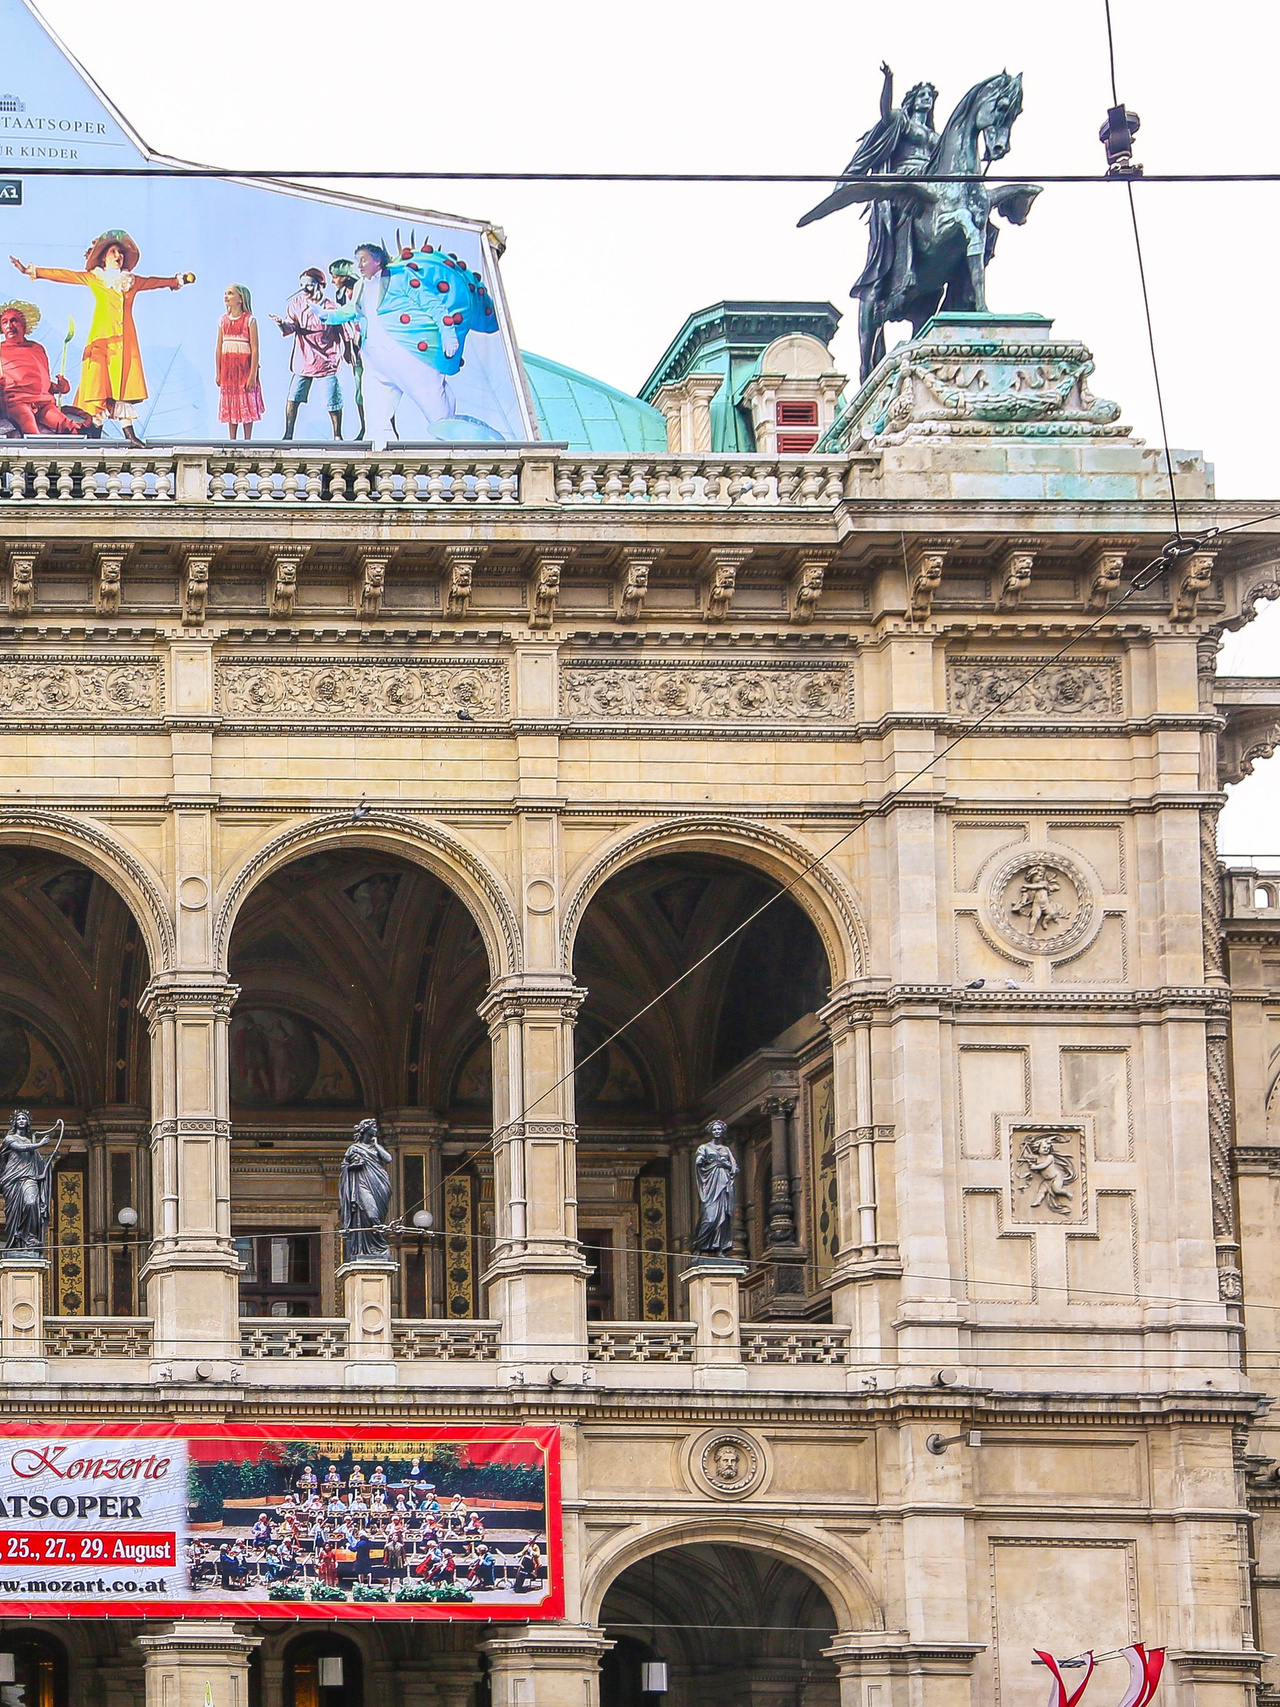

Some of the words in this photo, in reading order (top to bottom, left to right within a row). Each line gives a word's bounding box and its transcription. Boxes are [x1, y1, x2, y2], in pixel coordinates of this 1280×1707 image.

[20, 146, 79, 160] KINDER
[10, 1445, 171, 1480] Konzerte
[7, 1537, 40, 1561] 25.,
[45, 1538, 76, 1562] 27.,
[80, 1538, 109, 1560] 29.
[112, 1538, 171, 1563] August
